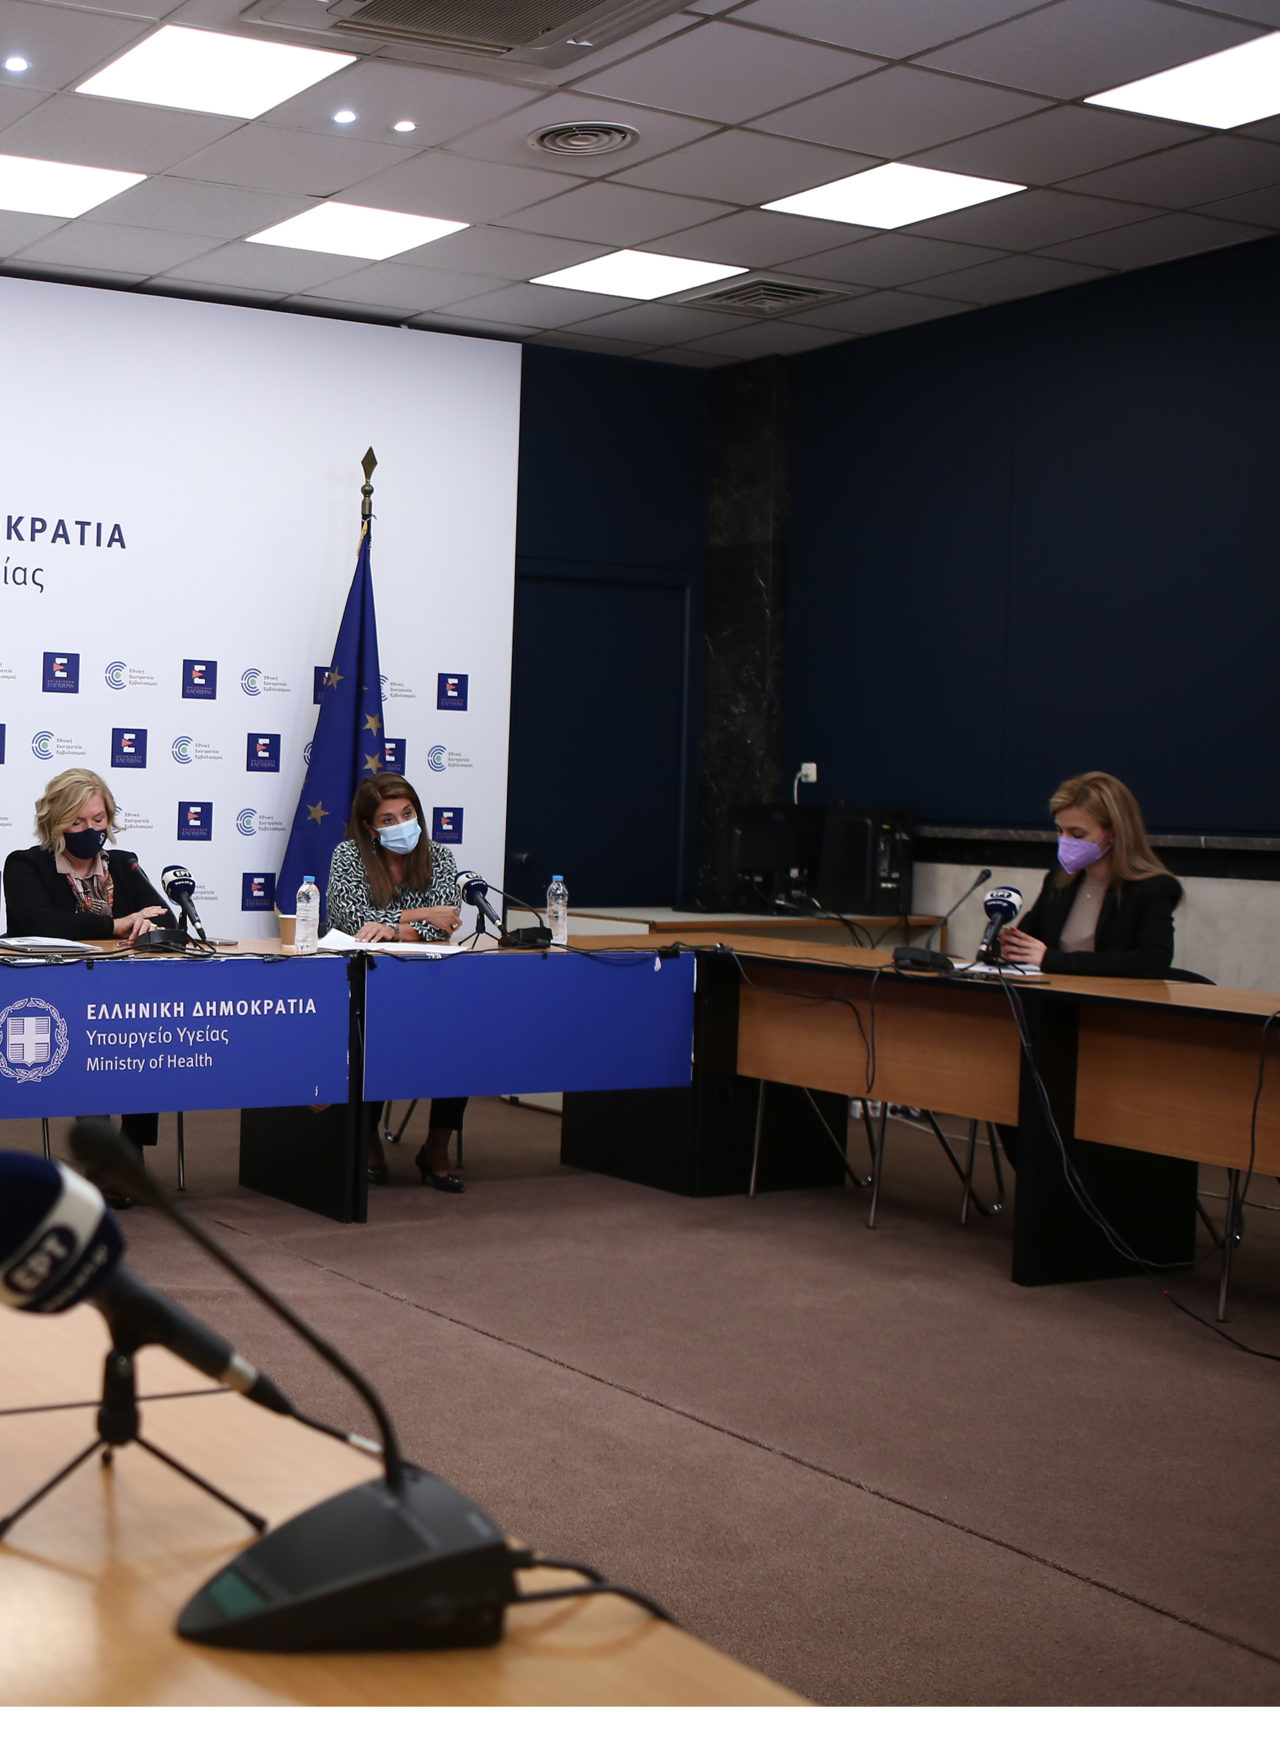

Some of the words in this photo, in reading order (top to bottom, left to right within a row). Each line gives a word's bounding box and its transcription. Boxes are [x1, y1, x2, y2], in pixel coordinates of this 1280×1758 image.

[87, 1002, 184, 1020] ΕΛΛΗΝΙΚΗ
[192, 998, 317, 1017] ΔΗΜΟΚΡΑΤΙΑ
[86, 1026, 172, 1048] Υπουργείο
[177, 1025, 229, 1046] Υγείας
[87, 1056, 145, 1073] Ministry
[150, 1055, 164, 1068] of
[167, 1053, 212, 1068] Health
